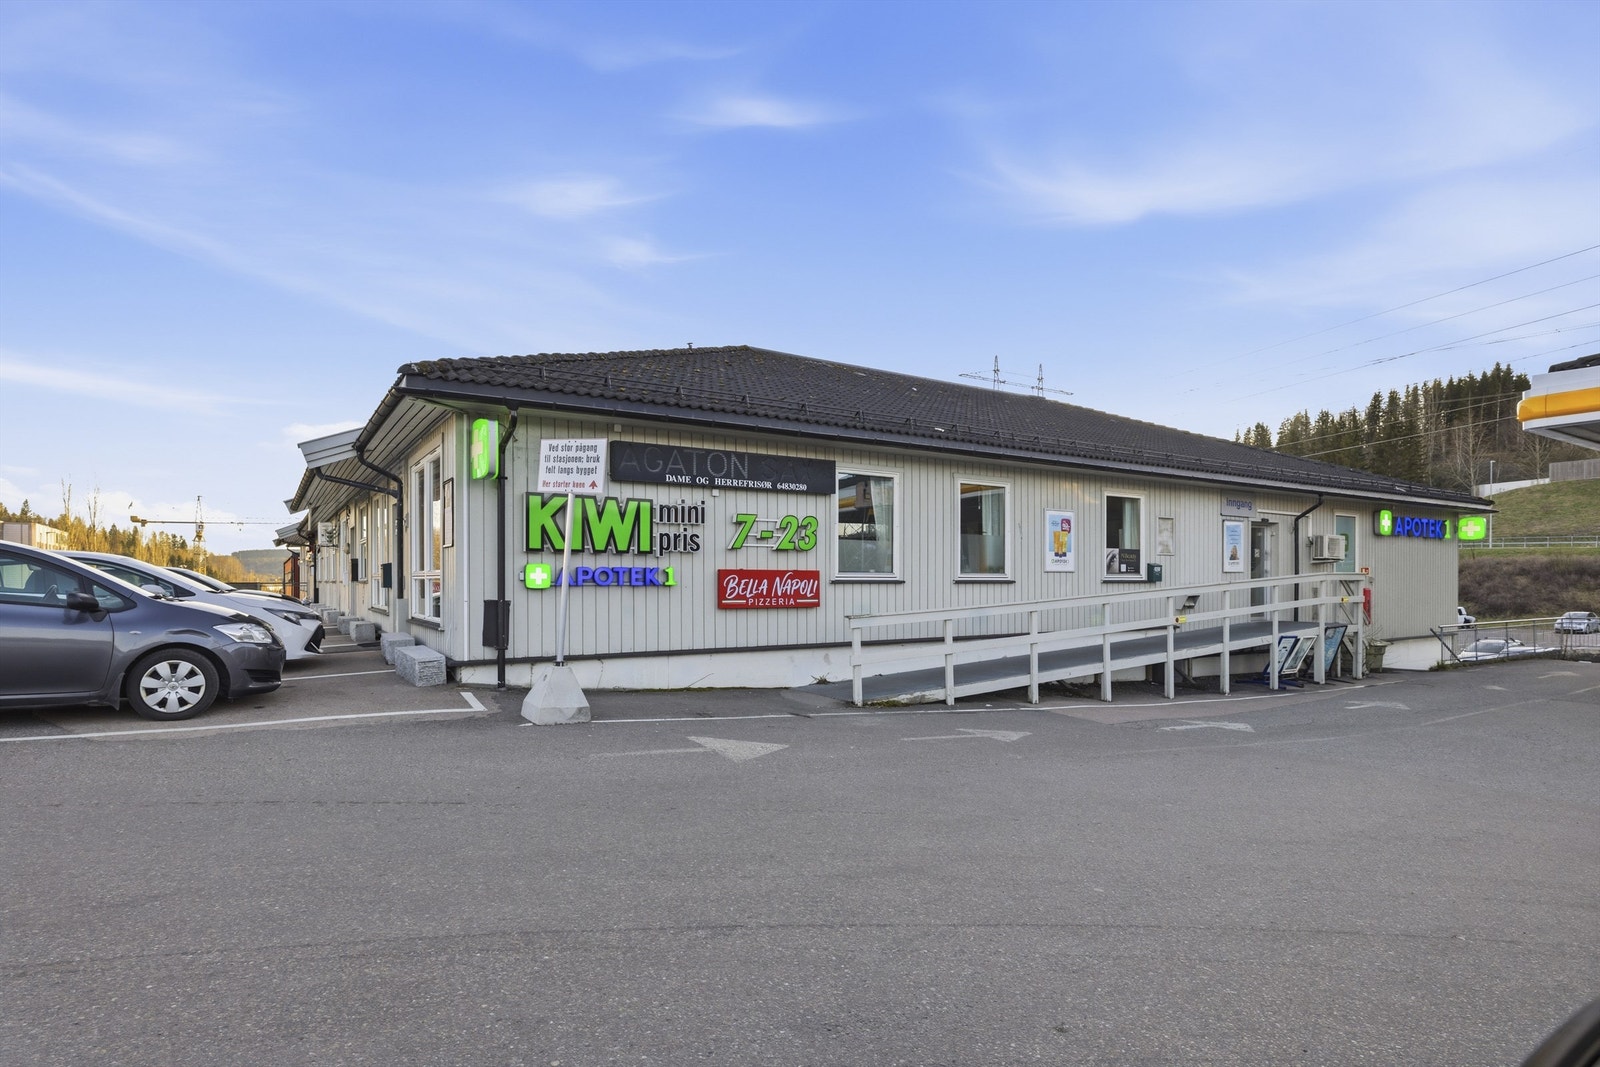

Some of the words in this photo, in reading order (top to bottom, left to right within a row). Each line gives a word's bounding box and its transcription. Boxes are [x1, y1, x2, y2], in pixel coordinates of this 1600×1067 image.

[548, 443, 559, 452] Ved
[561, 443, 573, 452] stor
[575, 442, 598, 453] pågang
[586, 454, 600, 463] bruk
[618, 447, 748, 479] AGATON
[545, 465, 556, 474] felt
[558, 465, 574, 475] langs
[576, 465, 598, 476] bygget
[665, 474, 692, 484] DAME
[696, 476, 709, 485] OG
[714, 478, 773, 490] HERREFRISØR
[776, 483, 808, 491] 64830280
[659, 499, 706, 524] mini
[1226, 497, 1253, 511] Inngang
[526, 492, 654, 554] KIWI
[1394, 516, 1444, 539] APOTEK
[1444, 519, 1451, 539] 1
[659, 527, 701, 556] pris
[555, 566, 662, 587] APOTEK
[663, 565, 677, 587] 1
[748, 598, 795, 606] PIZZERIA
